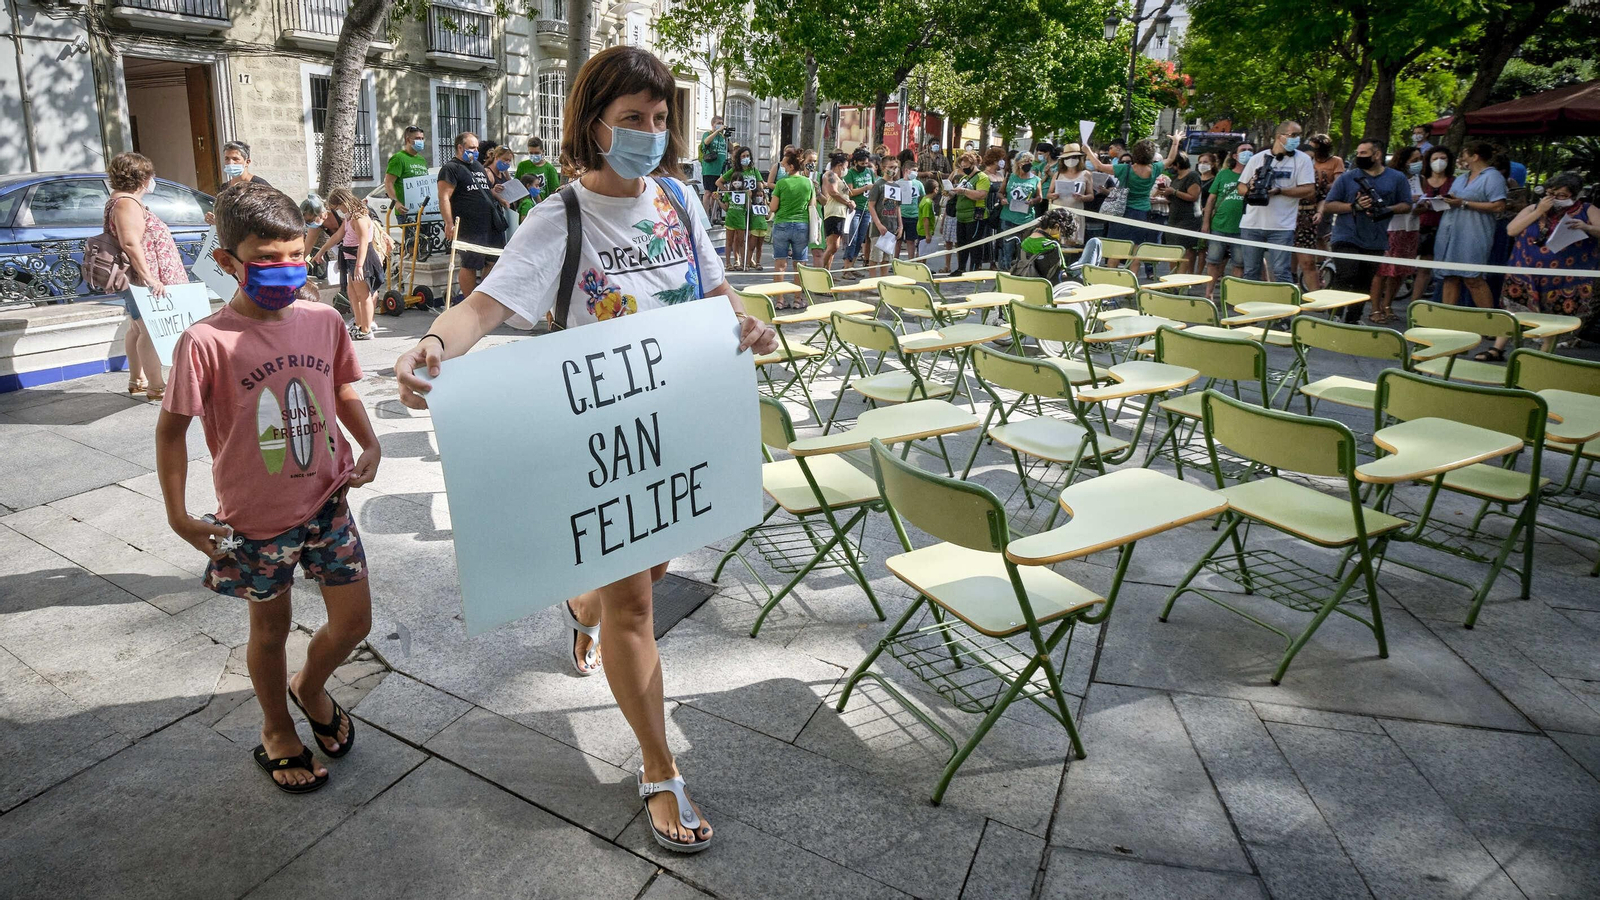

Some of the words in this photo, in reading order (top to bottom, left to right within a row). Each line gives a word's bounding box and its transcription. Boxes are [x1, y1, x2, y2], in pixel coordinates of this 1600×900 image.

[239, 74, 250, 84] 17
[743, 179, 755, 189] 23
[1074, 182, 1080, 193] 1
[890, 188, 896, 199] 2
[912, 187, 918, 197] 2
[1013, 190, 1023, 200] 2
[734, 195, 740, 203] 6
[754, 206, 767, 214] 10
[241, 354, 331, 390] SURFRIDER
[561, 337, 666, 415] C.E.I.P.
[273, 420, 327, 440] FREEDOM
[588, 412, 662, 488] SAN
[570, 460, 712, 566] FELIPE
